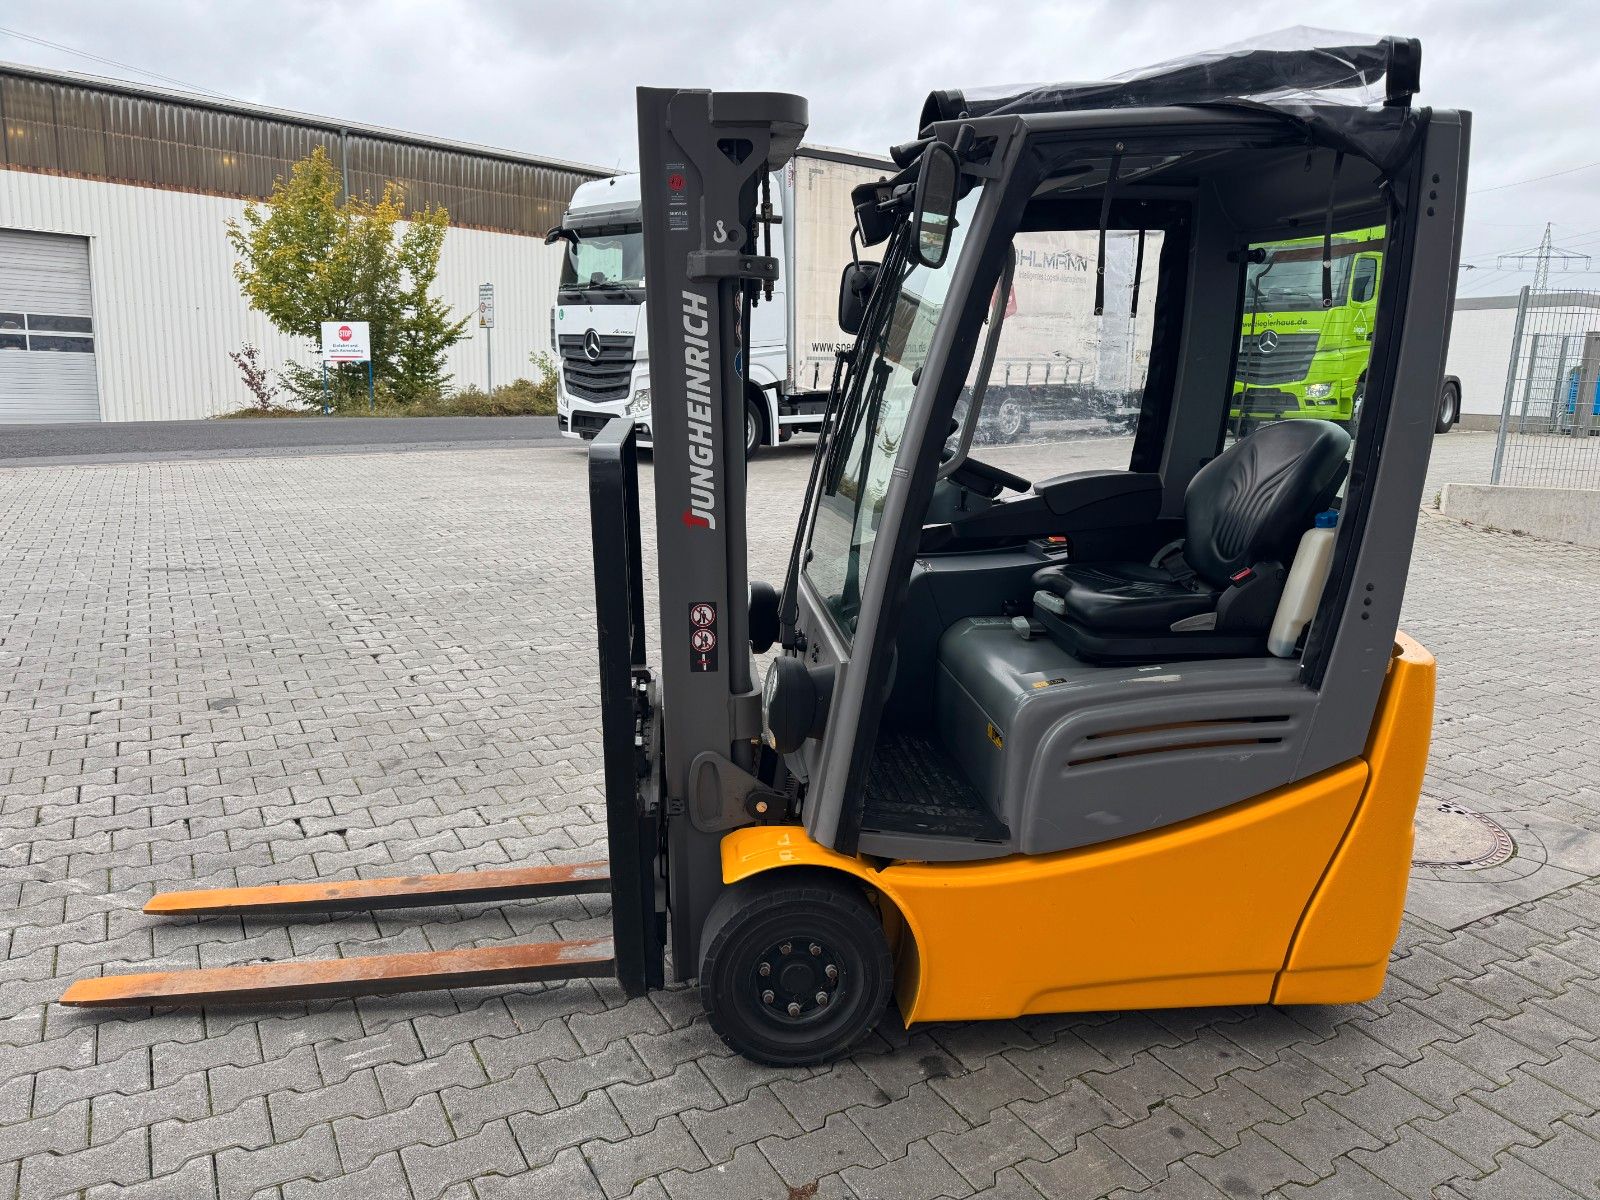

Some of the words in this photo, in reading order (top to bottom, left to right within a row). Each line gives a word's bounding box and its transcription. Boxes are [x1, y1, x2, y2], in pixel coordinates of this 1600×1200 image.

[339, 330, 353, 338] STOP
[811, 342, 855, 353] www.spe
[682, 290, 716, 530] JUNGHEINRICH
